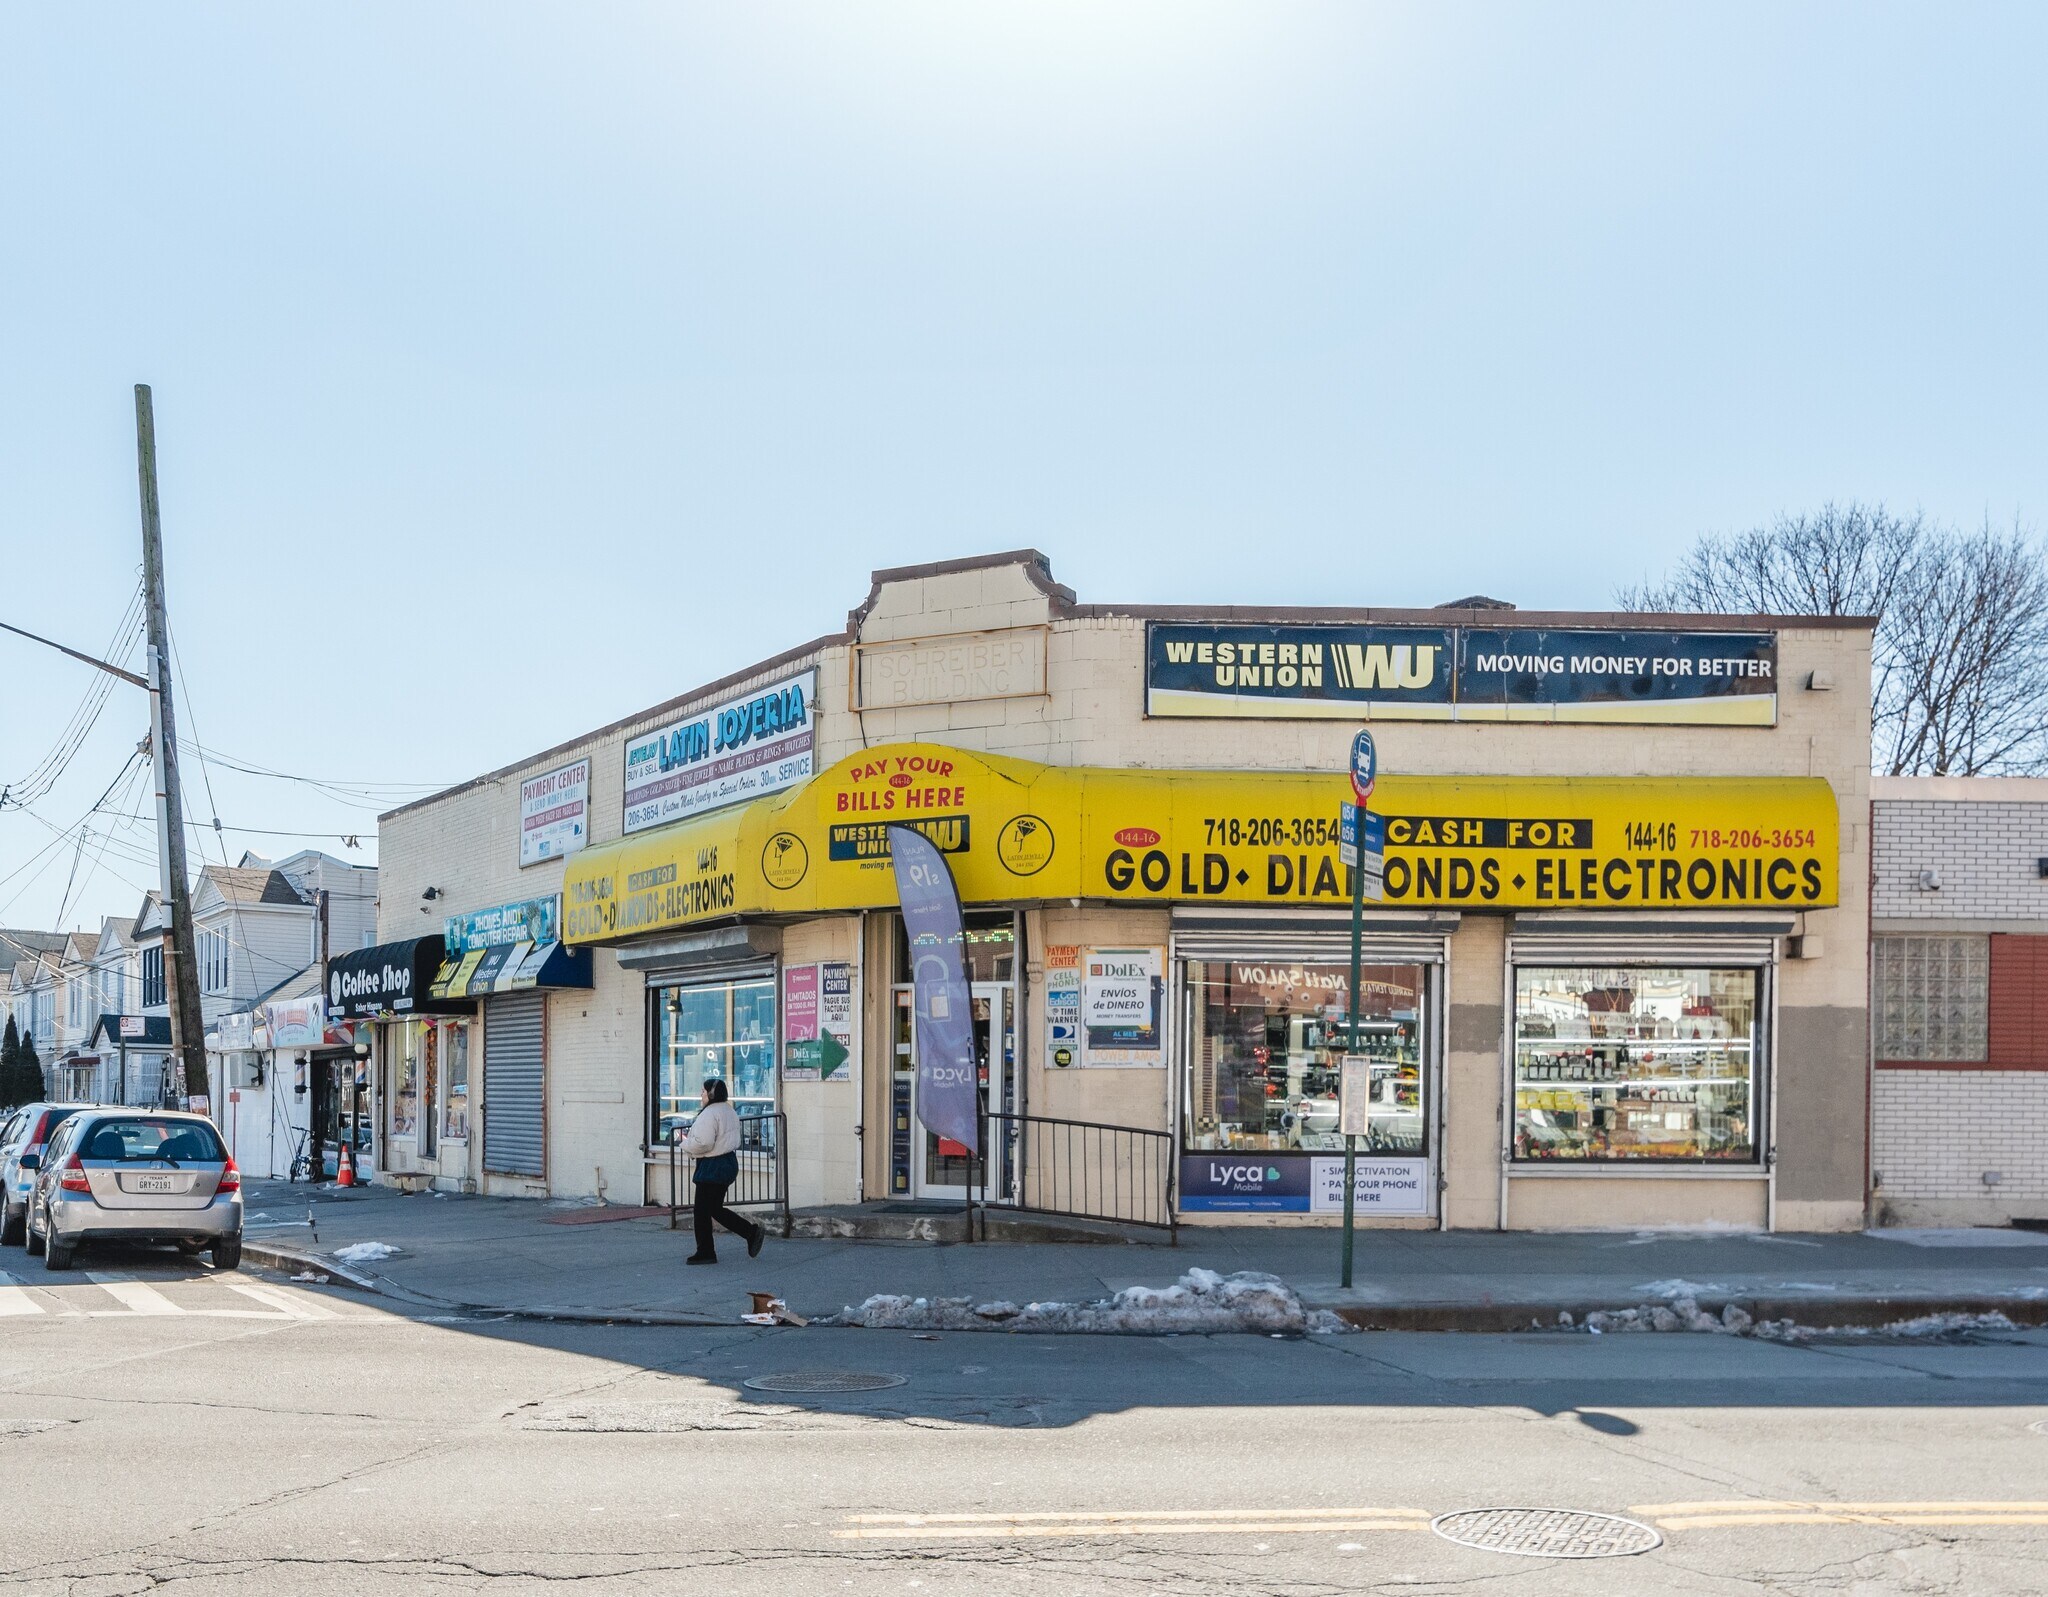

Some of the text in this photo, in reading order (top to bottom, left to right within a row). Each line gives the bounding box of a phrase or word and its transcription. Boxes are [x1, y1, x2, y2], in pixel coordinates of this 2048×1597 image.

[880, 641, 1025, 679] SCHREIBER
[1165, 641, 1322, 664] WESTERN
[1476, 654, 1772, 677] MOVING MONEY FOR BETTER
[1215, 665, 1322, 688] UNION
[658, 684, 807, 773] LATIN JOYERIA
[718, 760, 734, 774] NAME
[735, 753, 755, 768] PLATES
[784, 735, 811, 753] WATCHES
[627, 767, 639, 781] BUY
[645, 762, 658, 776] SELL
[850, 756, 954, 783] PAY YOUR
[524, 765, 586, 802] PAYMENT CENTER
[628, 804, 659, 826] 206-3654
[779, 757, 810, 781] SERVICE
[837, 786, 965, 812] BILLS HERE
[834, 825, 889, 842] WESTE
[1119, 832, 1156, 844] 144-16
[1204, 818, 1575, 847] 718-206-3654 CASH FOR
[1624, 822, 1815, 851] 144-16 718-206-3654
[860, 860, 885, 871] moving
[1105, 848, 1230, 893] GOLD
[1536, 857, 1822, 900] ELECTRONICS
[631, 866, 673, 889] CASH FOR
[568, 873, 734, 938] GOLD DIAMONDS ELECTRONICS
[475, 909, 518, 931] PHONES AND
[467, 924, 528, 949] COMPUTER REPAIR
[1046, 946, 1079, 956] PAYMENT
[1050, 956, 1077, 966] CENTER
[474, 968, 498, 980] Western
[1053, 970, 1074, 980] CELL
[1105, 963, 1146, 977] DolEx
[342, 964, 410, 998] Coffee Shop
[472, 980, 488, 992] Union
[825, 980, 848, 991] CENTER
[1047, 977, 1080, 990] PHONES
[1101, 987, 1137, 998] ENVÍOS
[1093, 1001, 1145, 1010] de DINERO
[1047, 1016, 1079, 1024] WARNER
[1210, 1162, 1263, 1185] Lyca
[1354, 1167, 1410, 1176] CTIVATION
[1233, 1183, 1263, 1192] Mobile
[1383, 1180, 1417, 1189] PHONE
[1357, 1193, 1381, 1201] HERE
